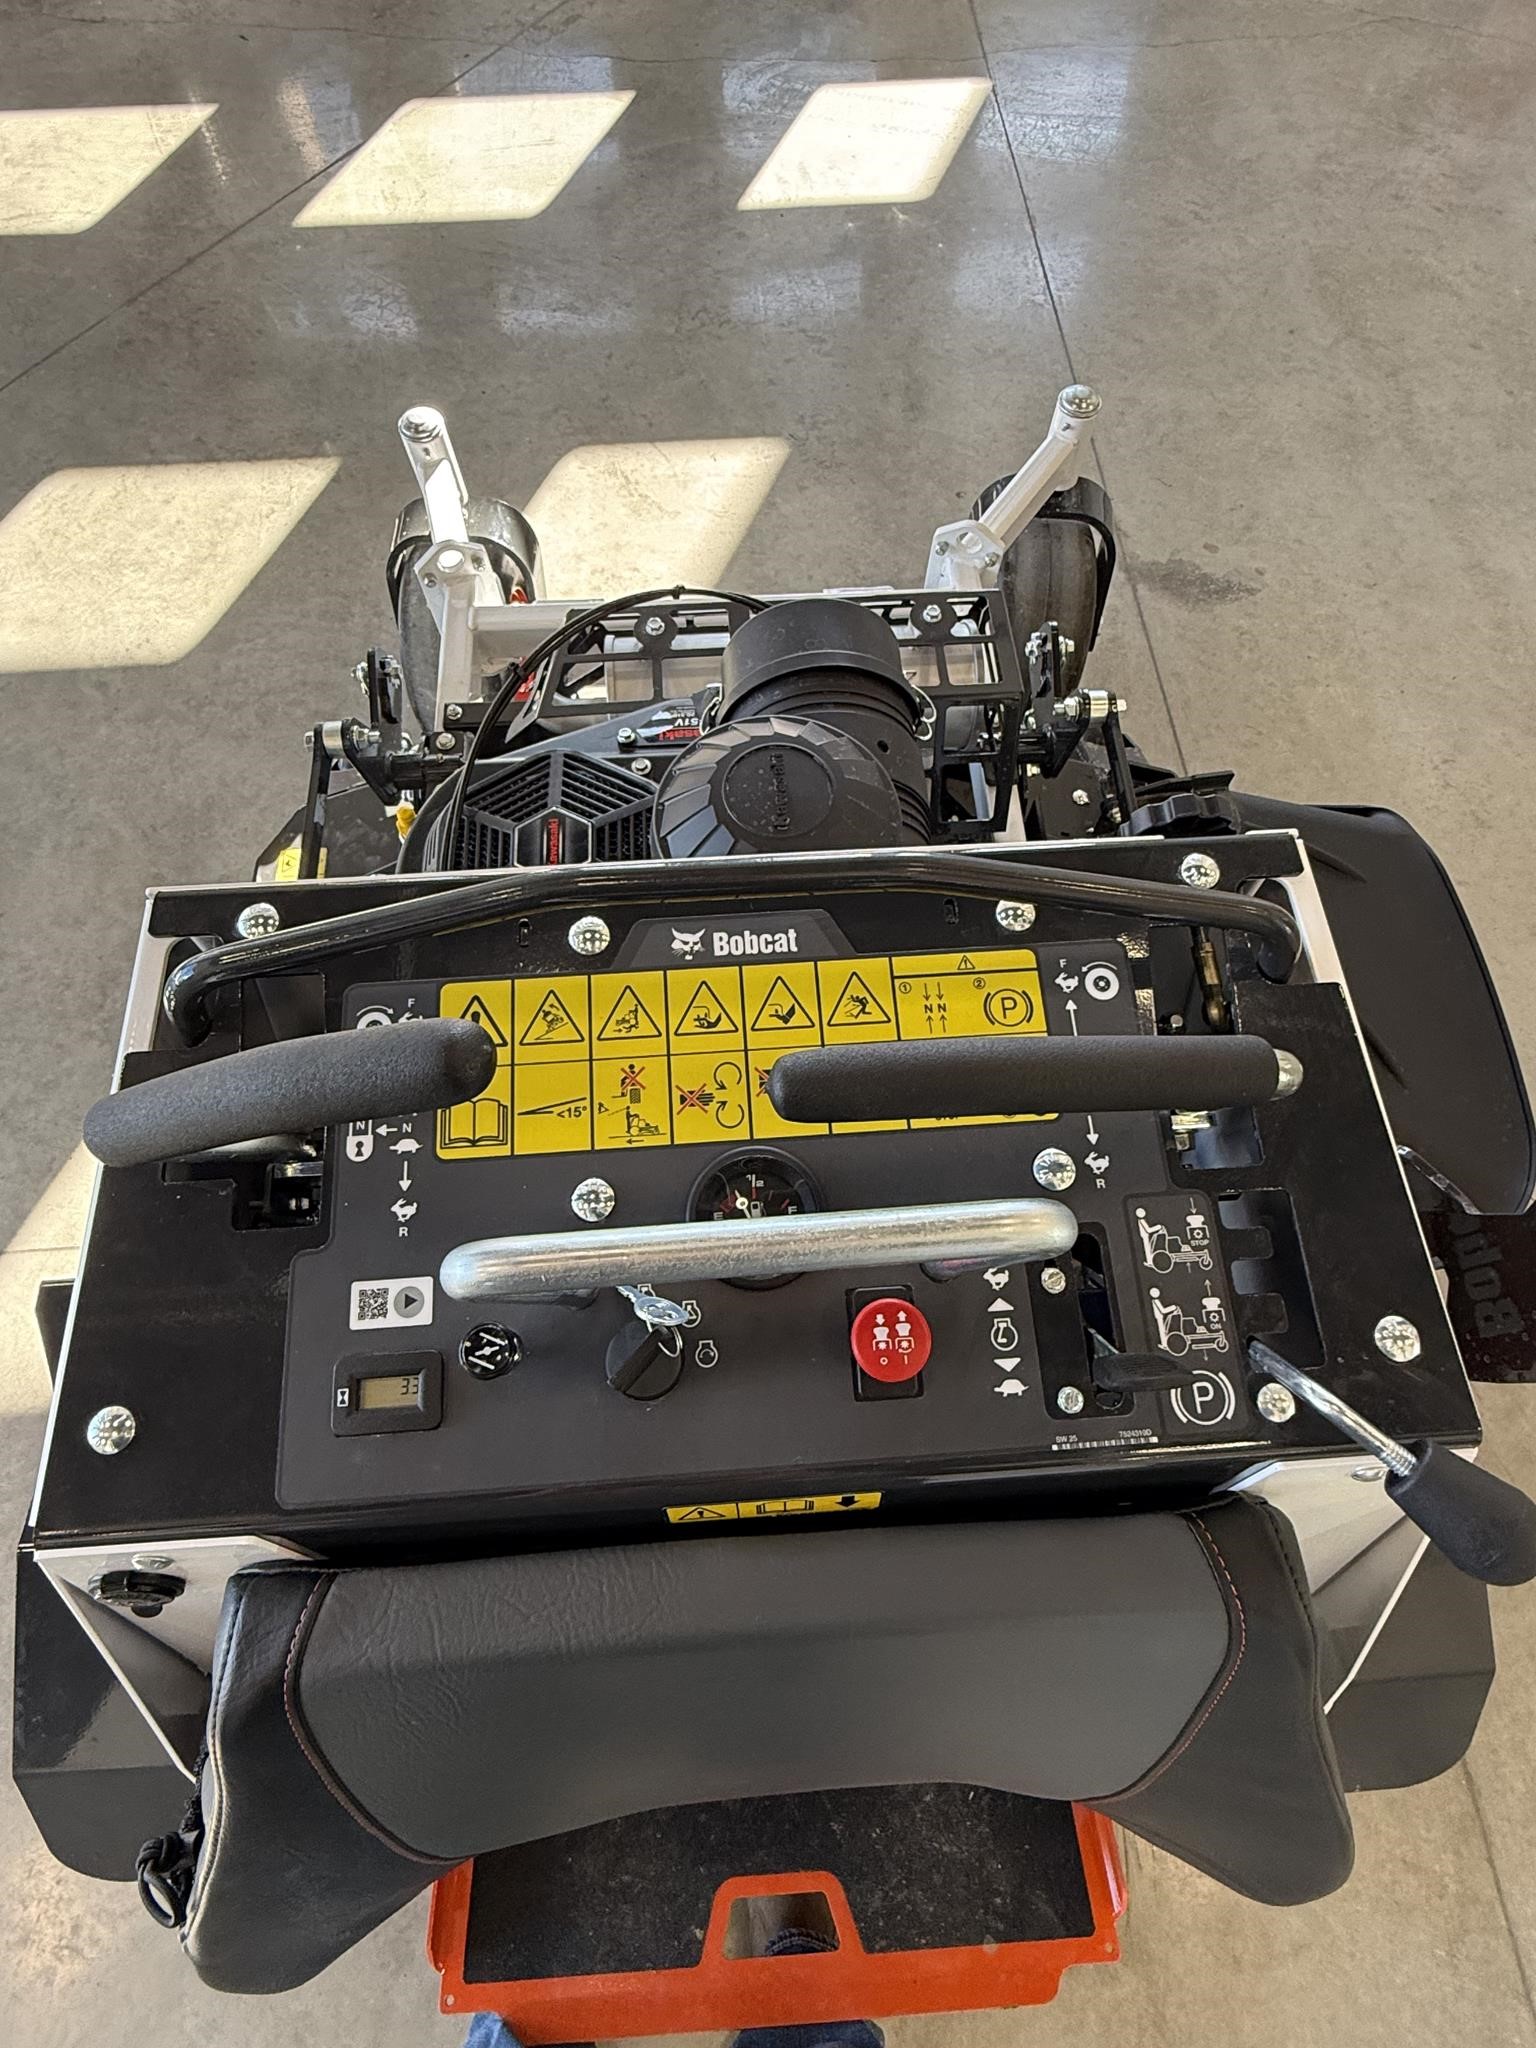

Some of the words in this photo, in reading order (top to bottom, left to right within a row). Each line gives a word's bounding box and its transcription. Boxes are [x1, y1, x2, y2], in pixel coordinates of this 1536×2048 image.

[548, 818, 559, 865] awasaki
[713, 929, 798, 956] Bobcat
[1060, 959, 1067, 968] F
[408, 998, 416, 1008] F
[924, 1004, 933, 1013] N
[938, 1003, 947, 1012] N
[1001, 997, 1018, 1019] P
[356, 1121, 366, 1130] N
[402, 1123, 412, 1133] N
[1096, 1179, 1106, 1189] R
[398, 1227, 408, 1237] R
[1192, 1382, 1214, 1414] P
